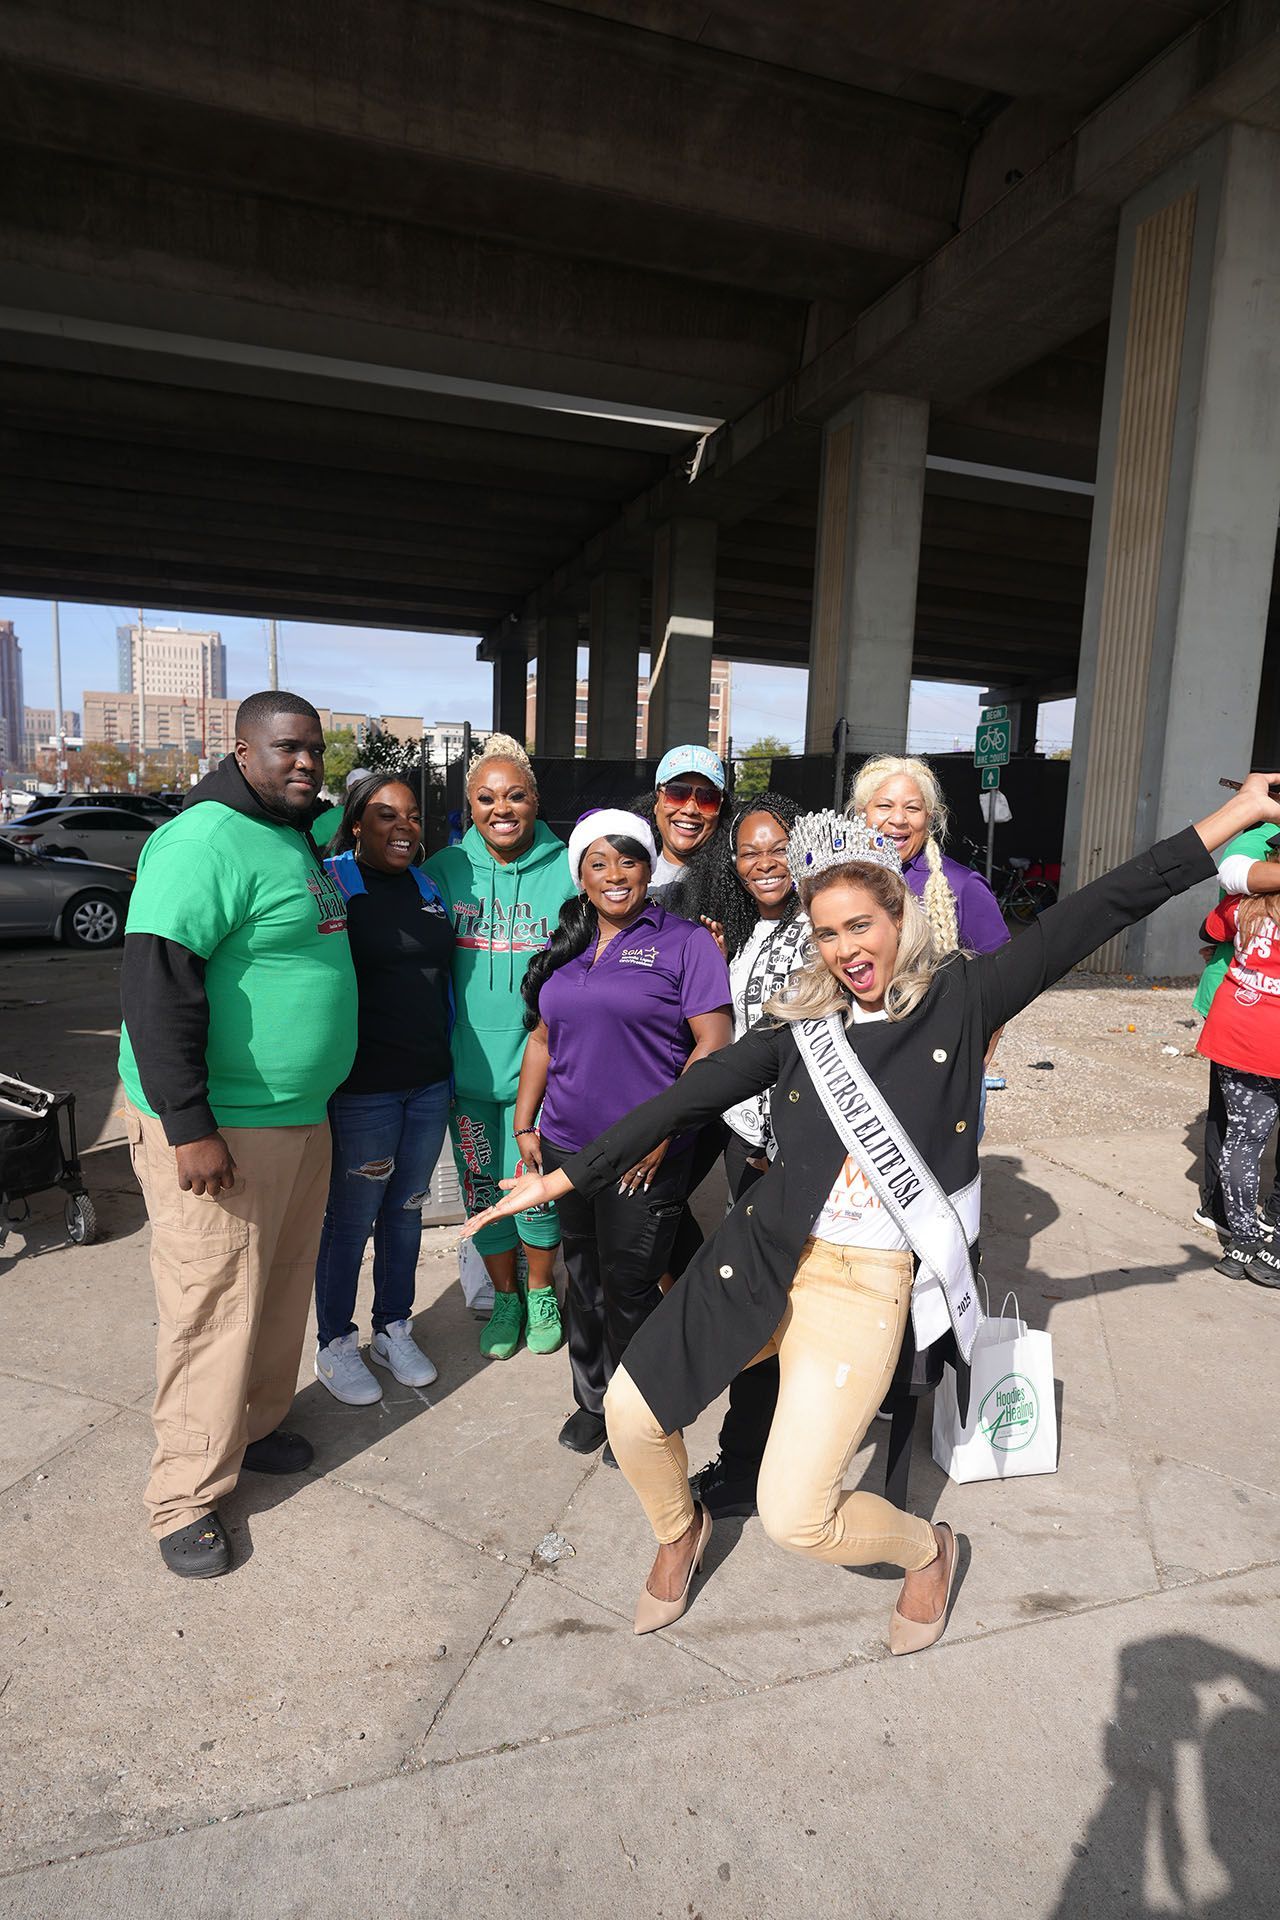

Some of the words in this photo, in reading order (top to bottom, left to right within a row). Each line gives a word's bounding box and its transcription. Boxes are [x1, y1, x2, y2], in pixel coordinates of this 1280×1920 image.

[985, 709, 1002, 720] BEGIN
[976, 754, 989, 765] BIKE
[488, 897, 534, 921] Am
[809, 1029, 872, 1125] UNIVERSE
[852, 1114, 906, 1178] ELITE
[887, 1166, 926, 1211] USA
[456, 1115, 482, 1175] Stripes
[957, 1292, 972, 1318] 2025
[996, 1387, 1026, 1408] Hoodies
[1005, 1400, 1034, 1423] Healing
